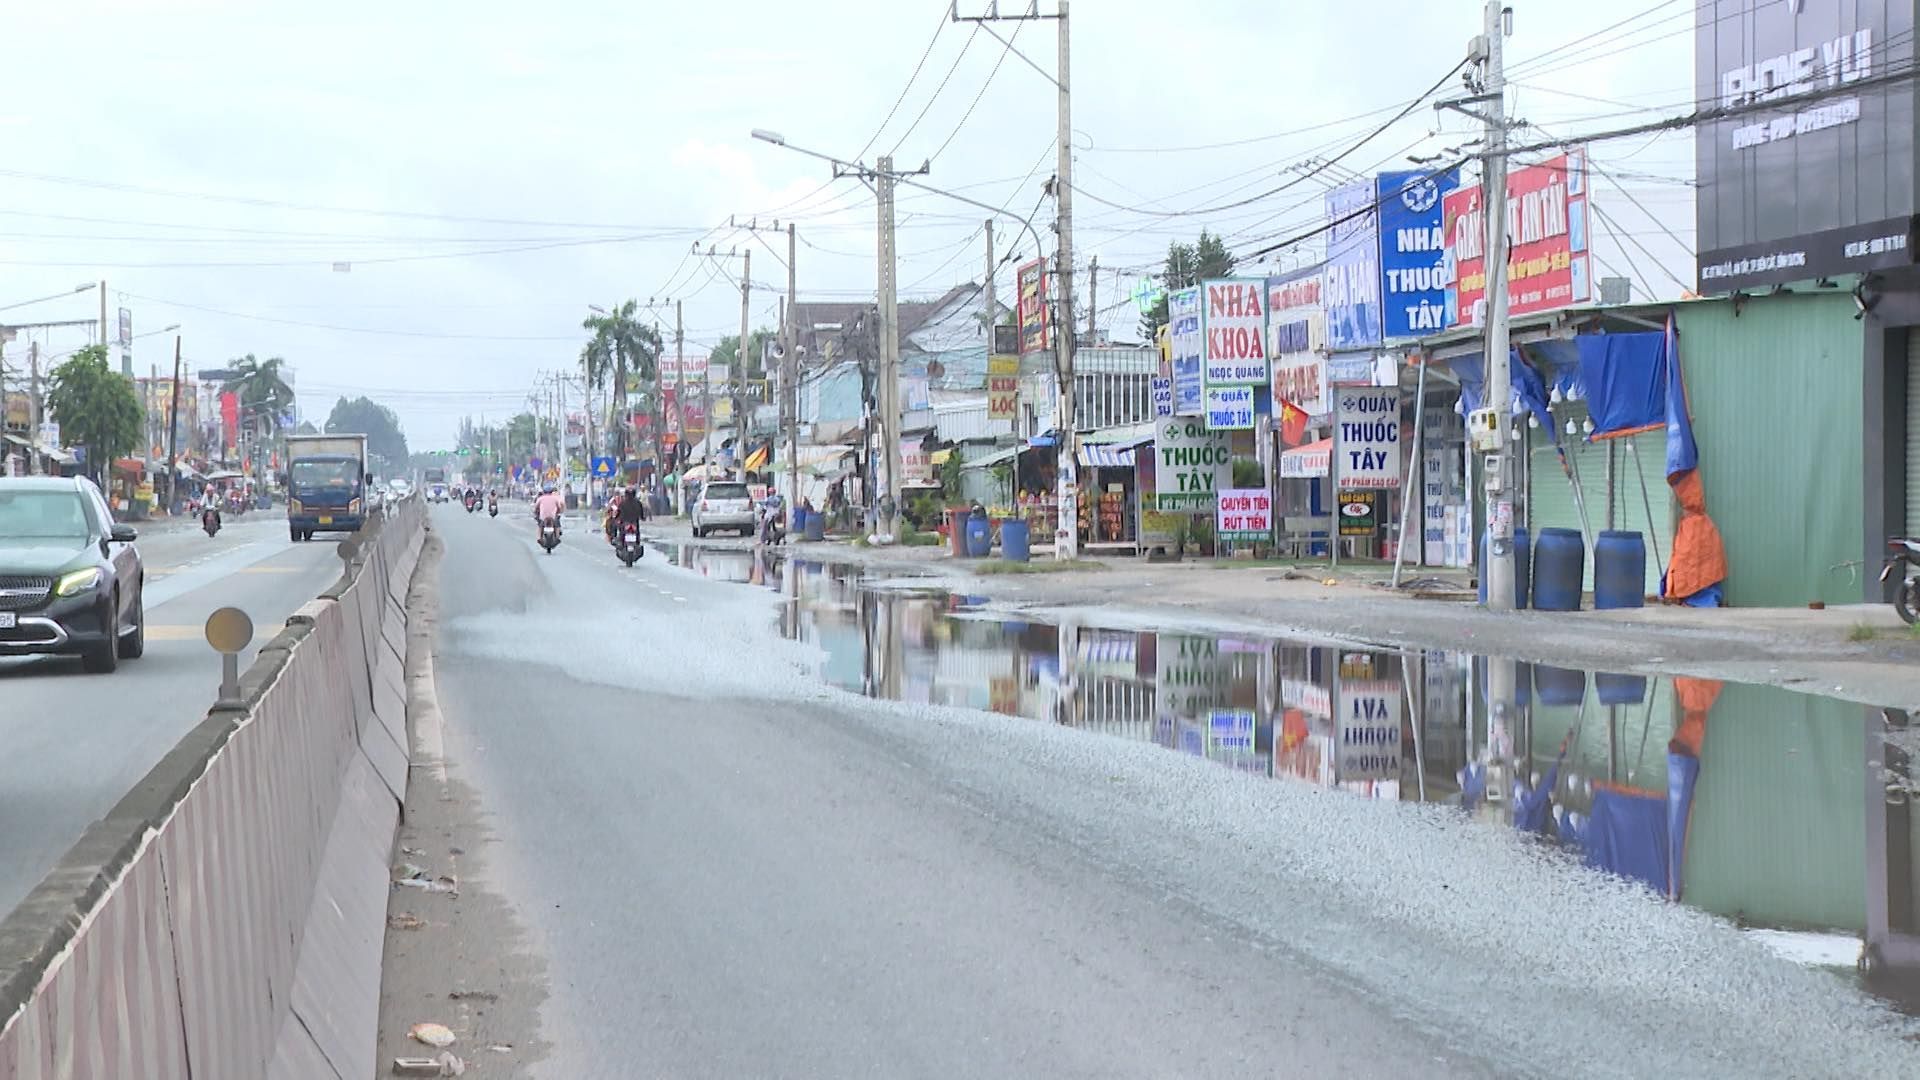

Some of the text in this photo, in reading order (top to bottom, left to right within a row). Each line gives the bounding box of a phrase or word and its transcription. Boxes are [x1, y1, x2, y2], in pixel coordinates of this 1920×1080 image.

[1209, 284, 1262, 318] NHA
[1405, 298, 1444, 331] TÂY
[1208, 326, 1264, 360] KHOA
[1153, 379, 1170, 390] BAO
[1209, 366, 1265, 381] NGỌC QUANG
[1154, 392, 1171, 402] CAO
[1341, 415, 1398, 443] THUỐC
[1162, 439, 1228, 466] THUỐC
[1349, 446, 1388, 471] TÂY
[1176, 467, 1214, 492] TÂY
